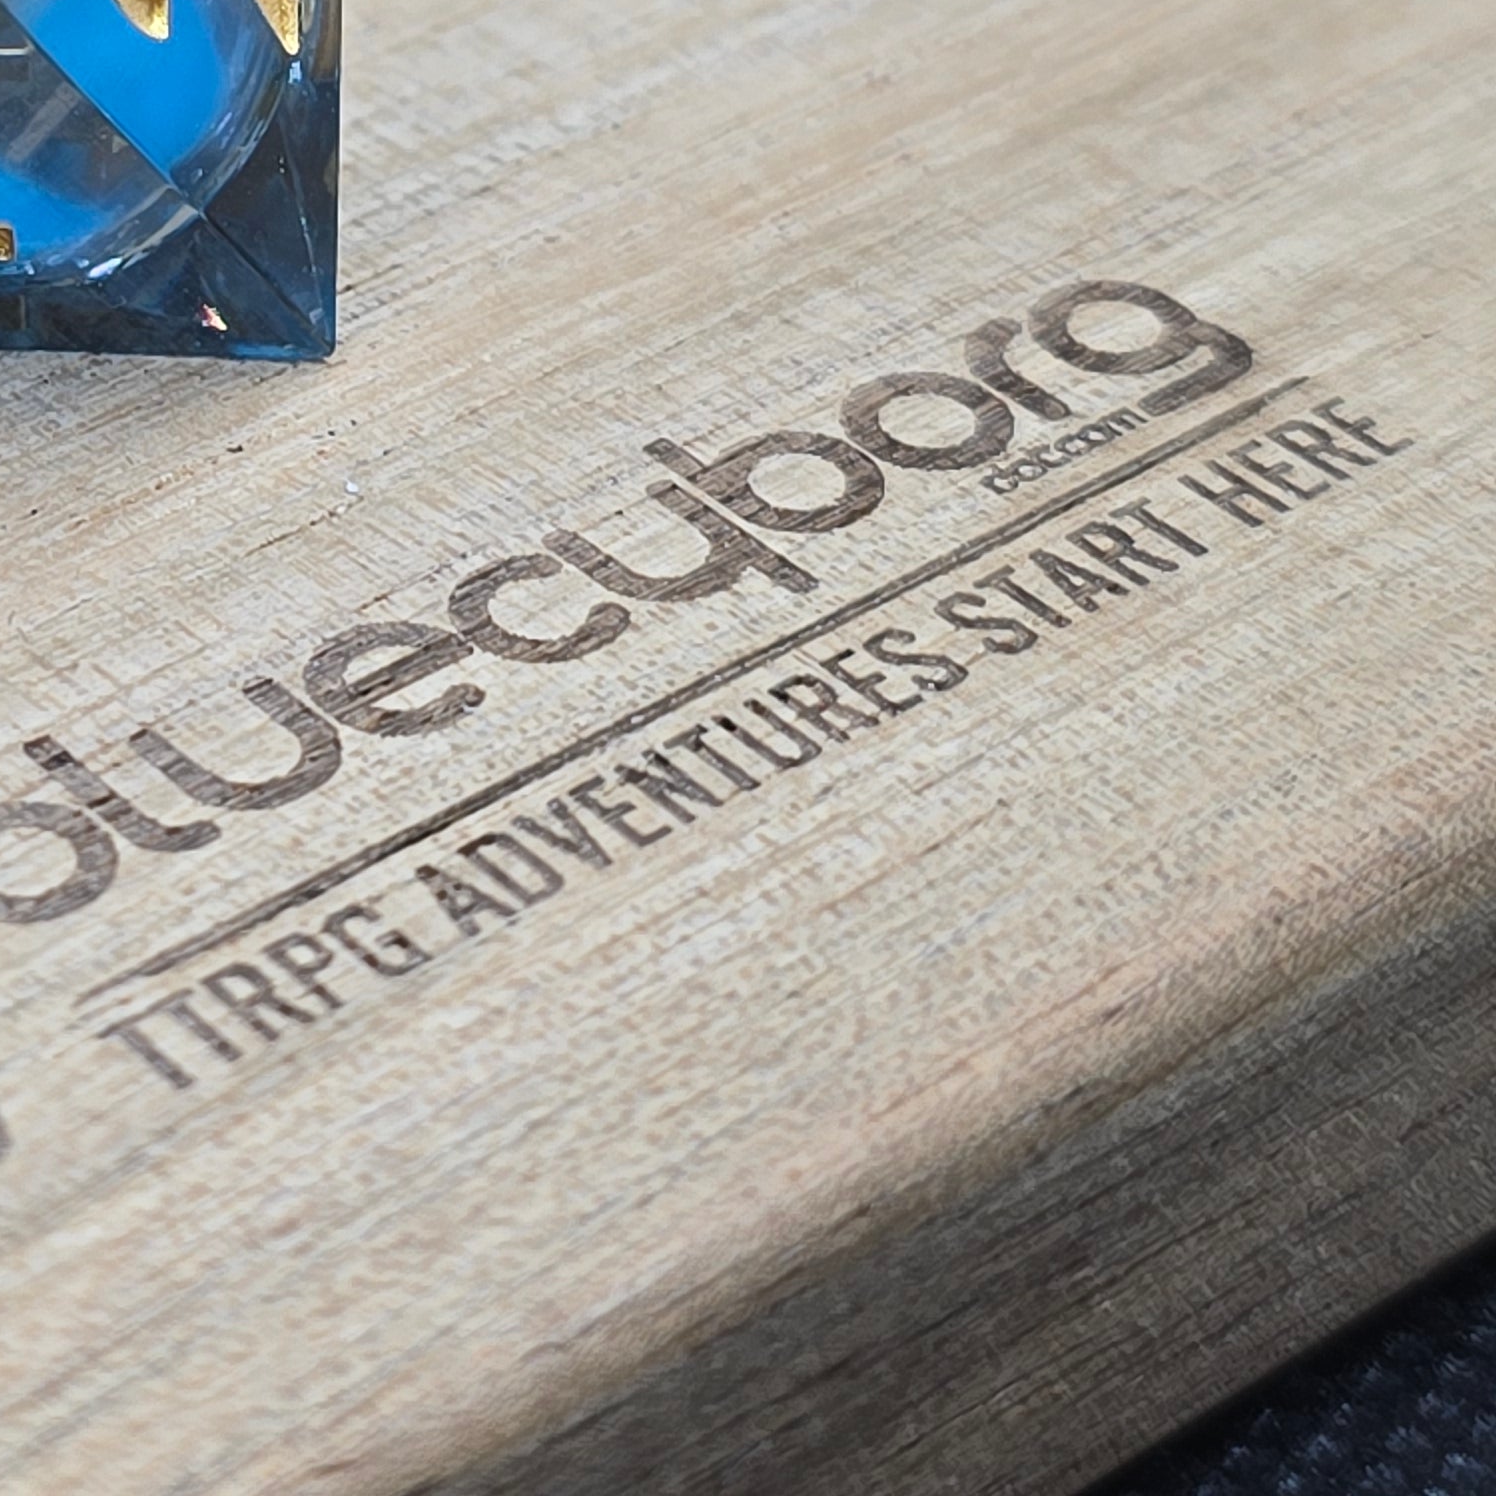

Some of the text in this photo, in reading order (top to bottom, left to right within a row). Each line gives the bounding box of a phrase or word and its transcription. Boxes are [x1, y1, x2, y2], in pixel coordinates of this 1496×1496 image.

[97, 396, 1413, 1089] TTRPG ADVENTURES START HERE
